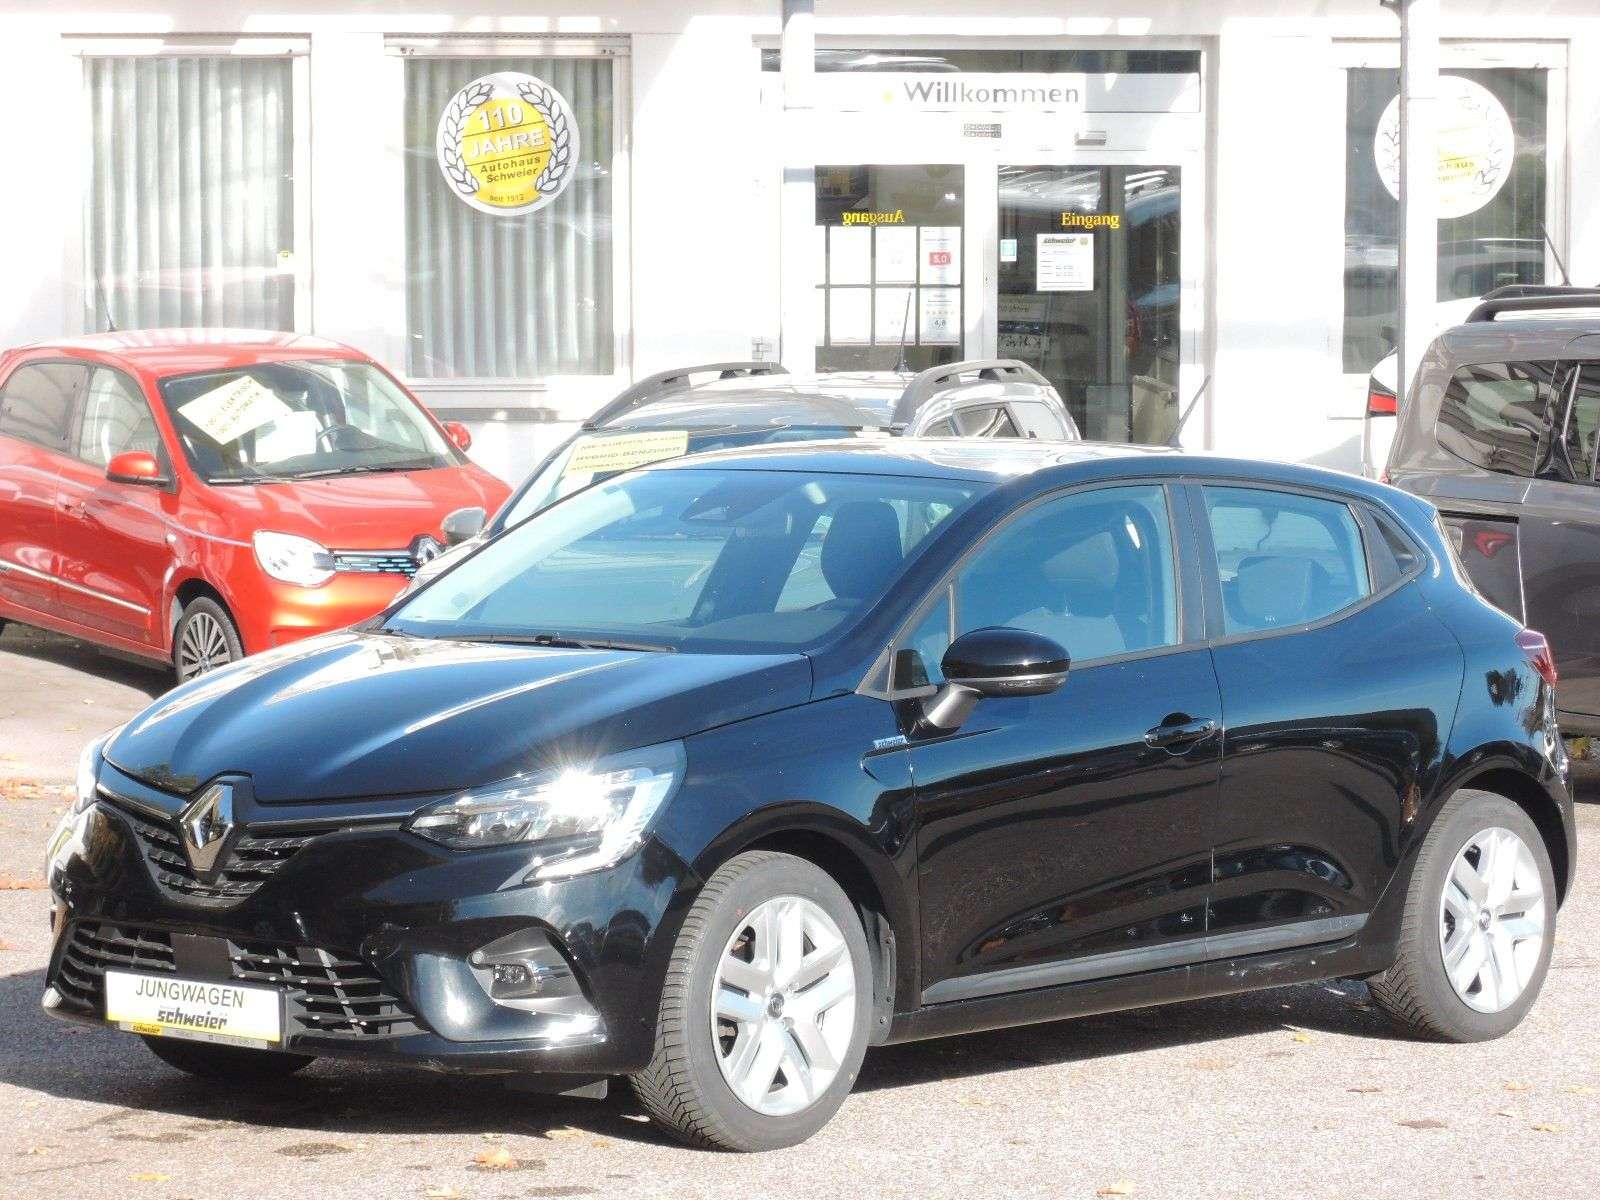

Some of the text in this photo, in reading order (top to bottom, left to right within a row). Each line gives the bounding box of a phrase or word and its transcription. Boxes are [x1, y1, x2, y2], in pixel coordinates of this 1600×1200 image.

[904, 81, 1079, 103] Willkommen
[480, 104, 524, 131] 110
[472, 128, 545, 157] JAHRE
[480, 155, 541, 174] Autohaus
[486, 167, 538, 183] Schweier
[1061, 212, 1121, 229] Eingang
[135, 978, 244, 1009] JUNGWAGEN
[157, 1007, 228, 1029] schweier
